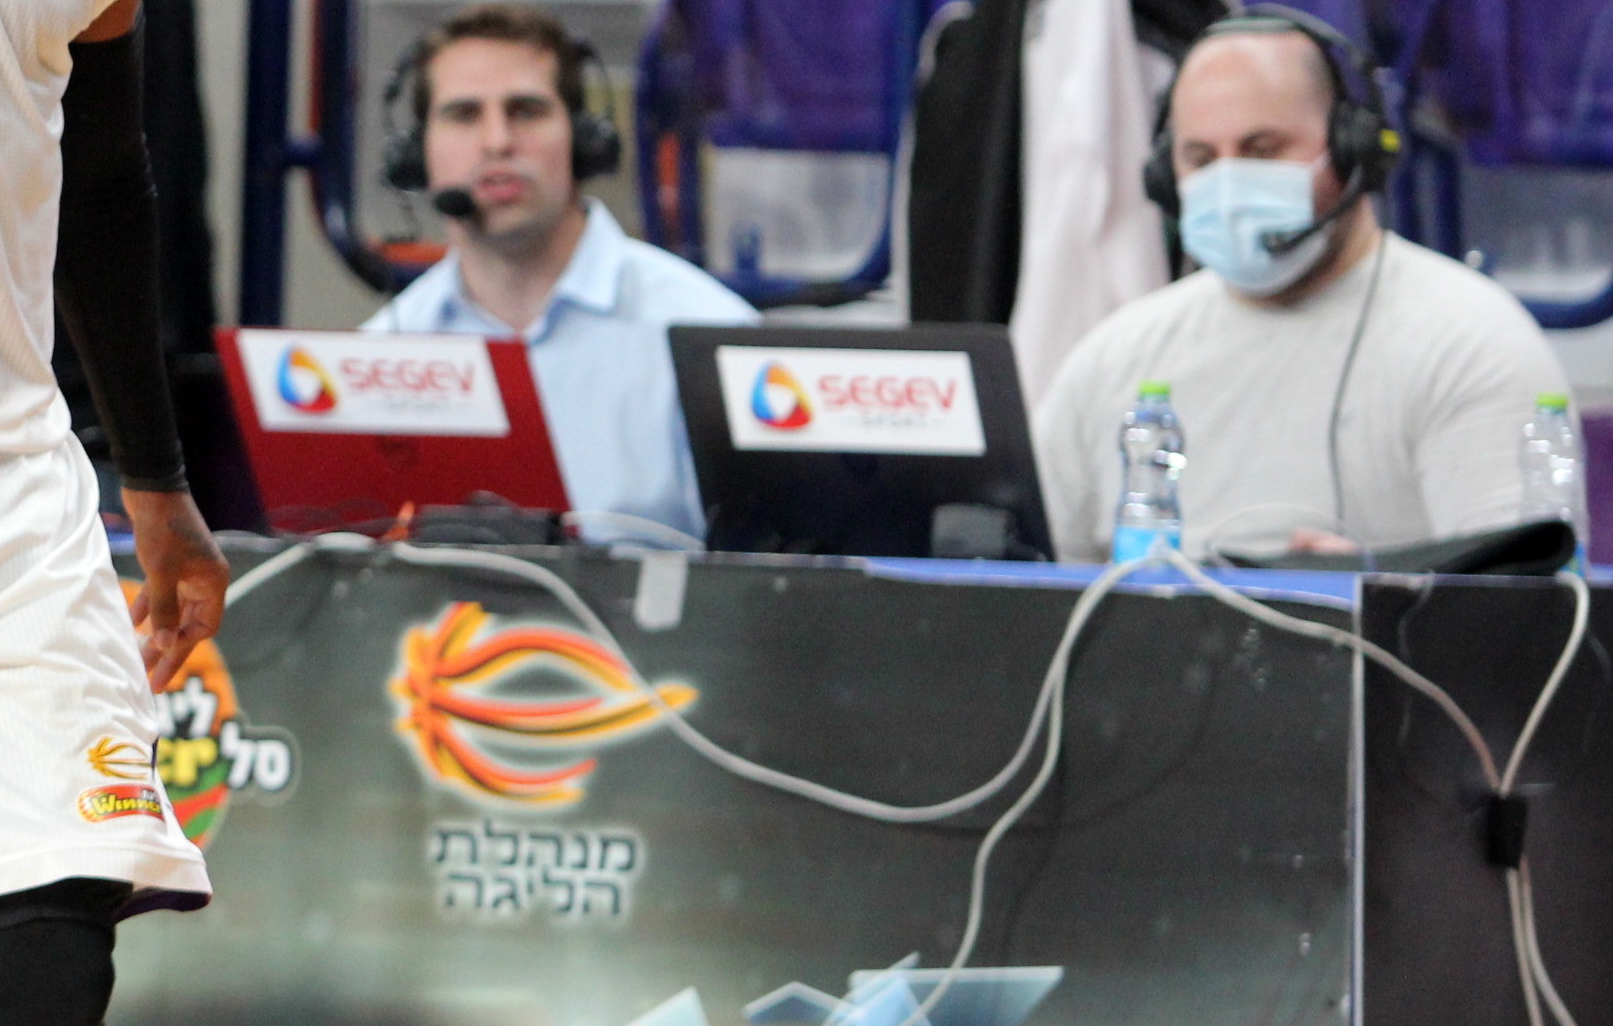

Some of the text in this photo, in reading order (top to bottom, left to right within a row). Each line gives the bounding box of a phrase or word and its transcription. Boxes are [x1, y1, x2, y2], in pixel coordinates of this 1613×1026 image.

[340, 356, 475, 395] SEGEV
[817, 374, 958, 411] SEGEV
[220, 720, 291, 792] סל
[435, 817, 636, 871] מנהלת
[445, 865, 621, 916] הליגה
